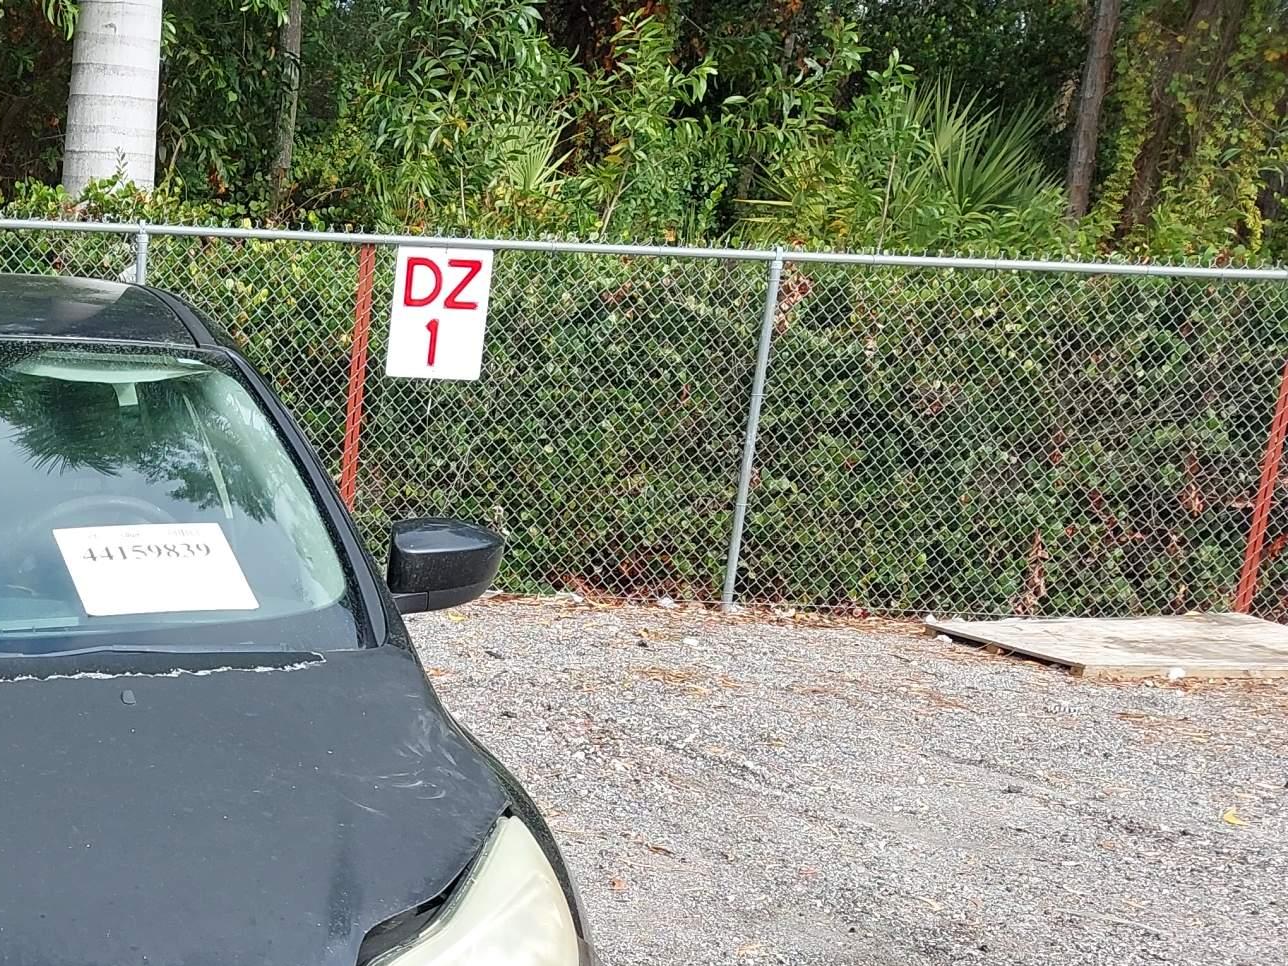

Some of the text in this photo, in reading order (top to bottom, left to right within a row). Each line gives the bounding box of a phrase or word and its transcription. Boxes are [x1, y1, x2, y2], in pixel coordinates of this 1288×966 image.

[403, 256, 483, 310] DZ
[425, 318, 439, 367] 1
[82, 543, 211, 562] 44159839
